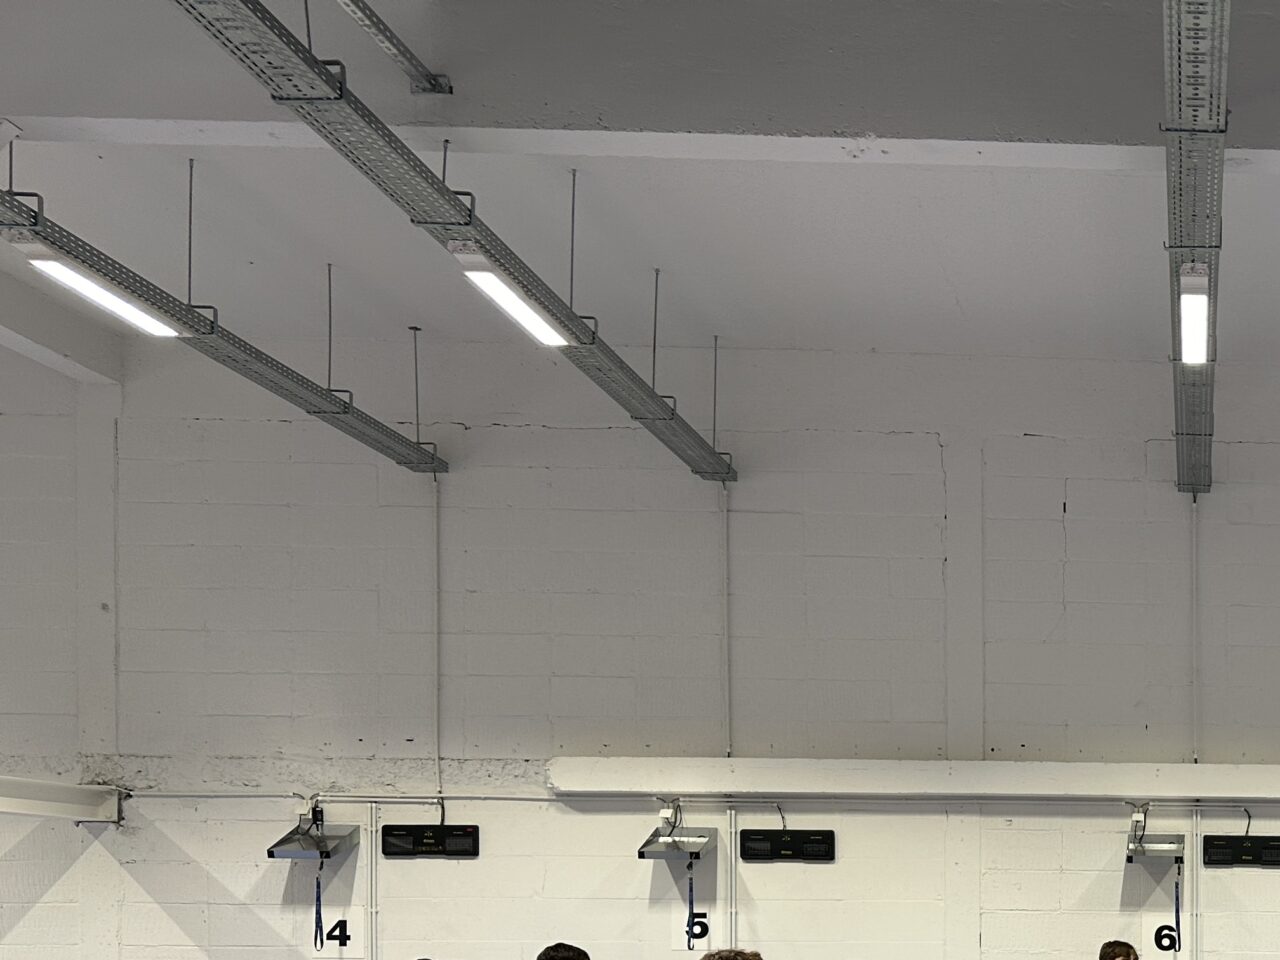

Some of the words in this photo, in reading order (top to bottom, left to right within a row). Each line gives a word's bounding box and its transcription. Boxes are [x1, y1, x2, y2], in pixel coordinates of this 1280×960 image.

[326, 919, 351, 947] 4
[685, 912, 709, 939] 5
[1154, 925, 1177, 951] 6
